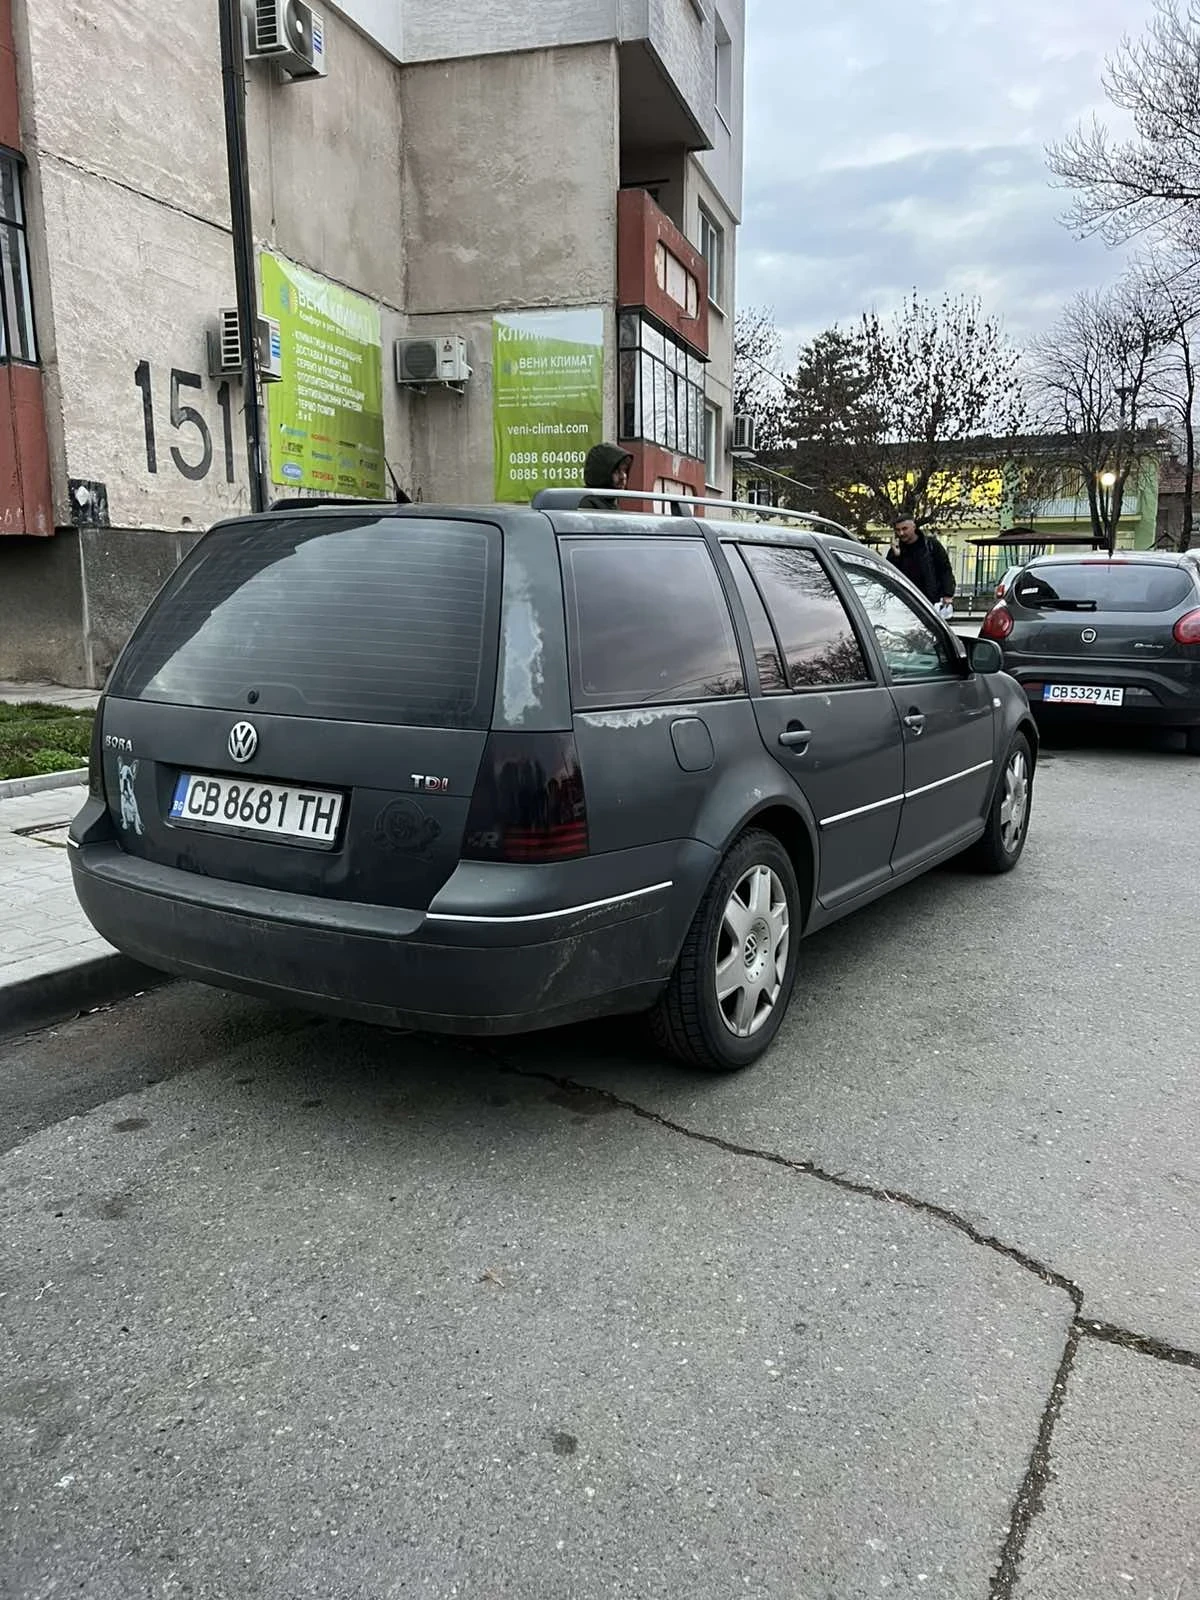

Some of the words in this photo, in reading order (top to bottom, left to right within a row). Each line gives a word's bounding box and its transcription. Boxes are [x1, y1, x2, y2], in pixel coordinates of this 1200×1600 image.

[520, 356, 548, 369] ВЕНИ
[551, 354, 594, 368] КЛИМАТ
[135, 360, 234, 483] 151
[507, 422, 589, 435] veni-climat.com
[510, 452, 538, 464] 0898
[542, 451, 586, 463] 604060
[510, 469, 538, 480] 0885
[542, 467, 585, 480] 101381
[1052, 687, 1068, 698] CB
[1070, 687, 1102, 700] 5329
[1104, 689, 1121, 701] AE
[105, 735, 133, 752] BORA
[411, 774, 449, 791] TDI
[173, 800, 184, 811] BG
[188, 780, 221, 817] CB
[224, 785, 289, 828] 8681
[298, 794, 336, 835] TH
